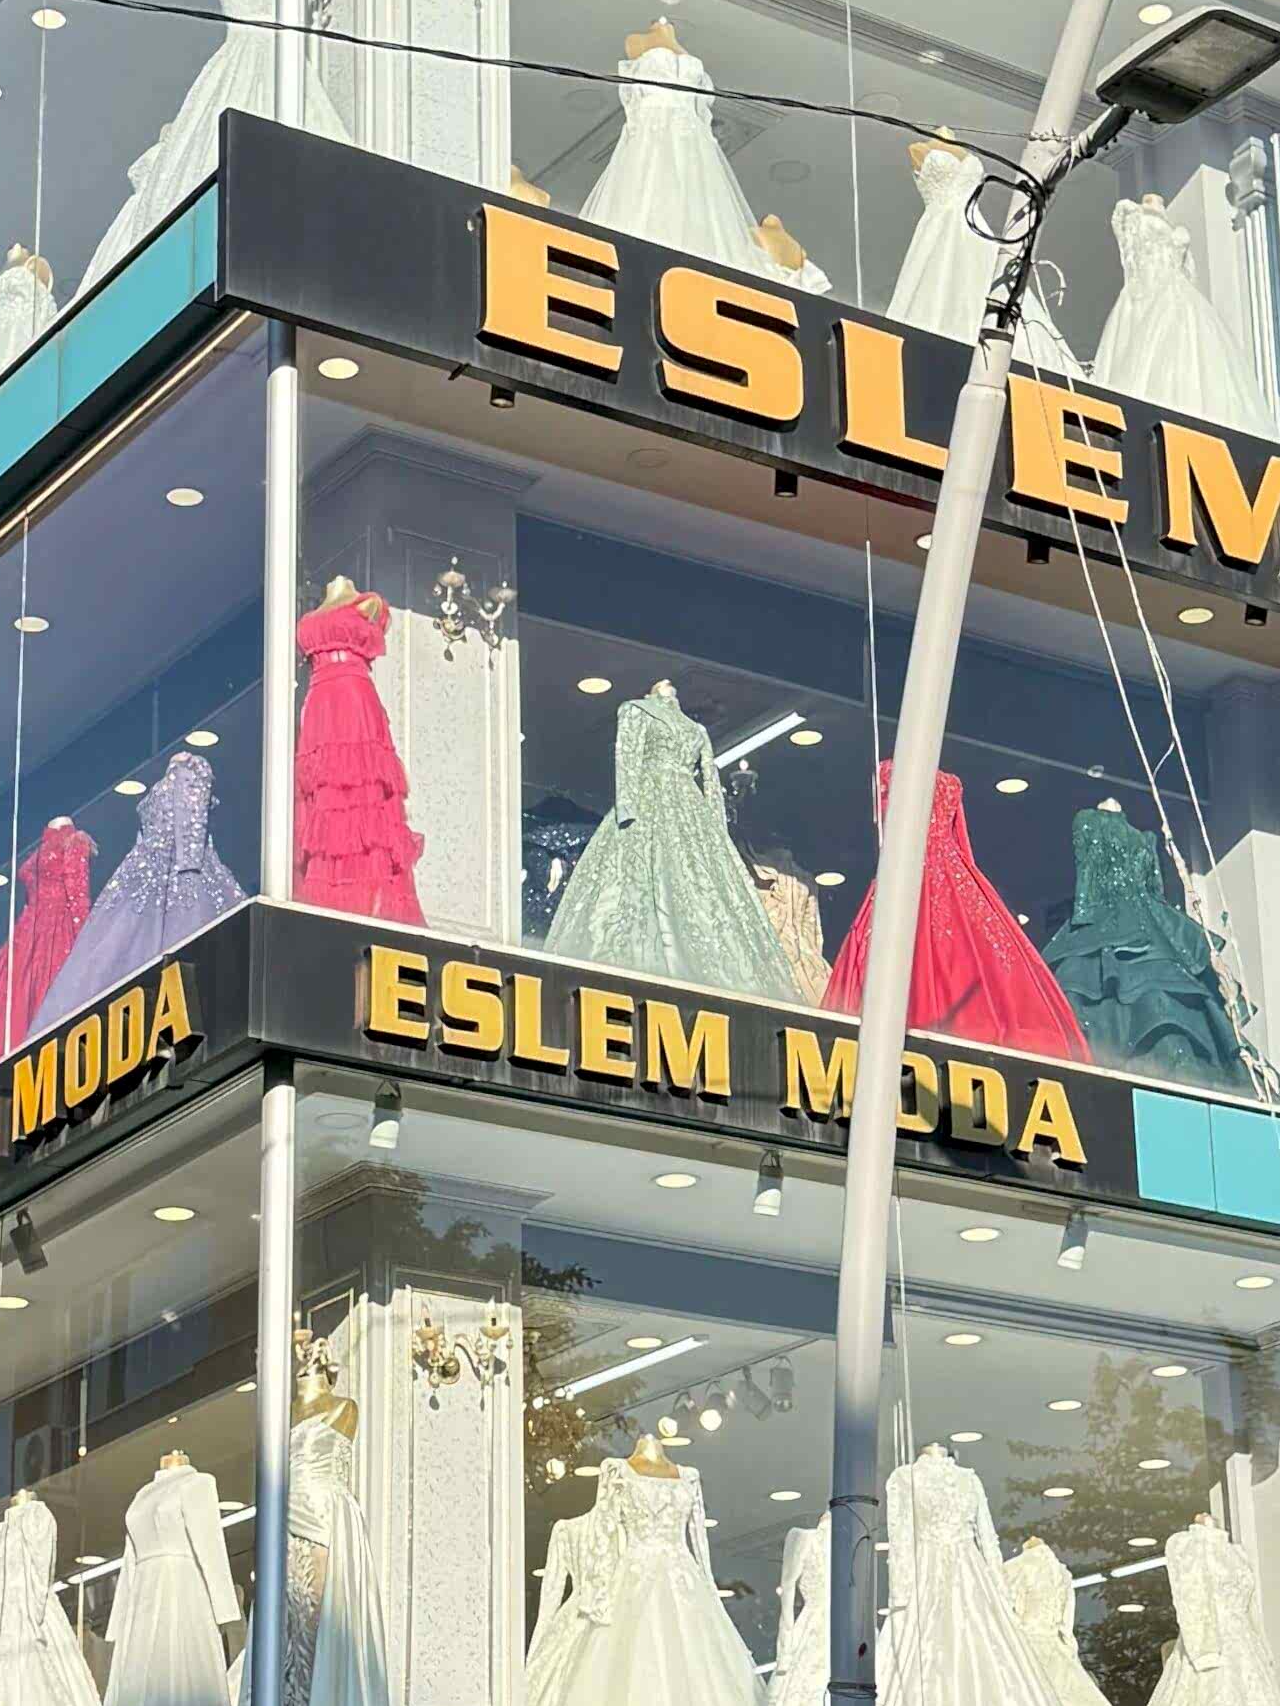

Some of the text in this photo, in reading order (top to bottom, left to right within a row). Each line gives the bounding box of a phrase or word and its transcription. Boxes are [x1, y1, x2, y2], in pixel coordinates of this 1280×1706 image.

[10, 959, 193, 1144] MODA
[364, 943, 1087, 1164] ESLEM MODA
